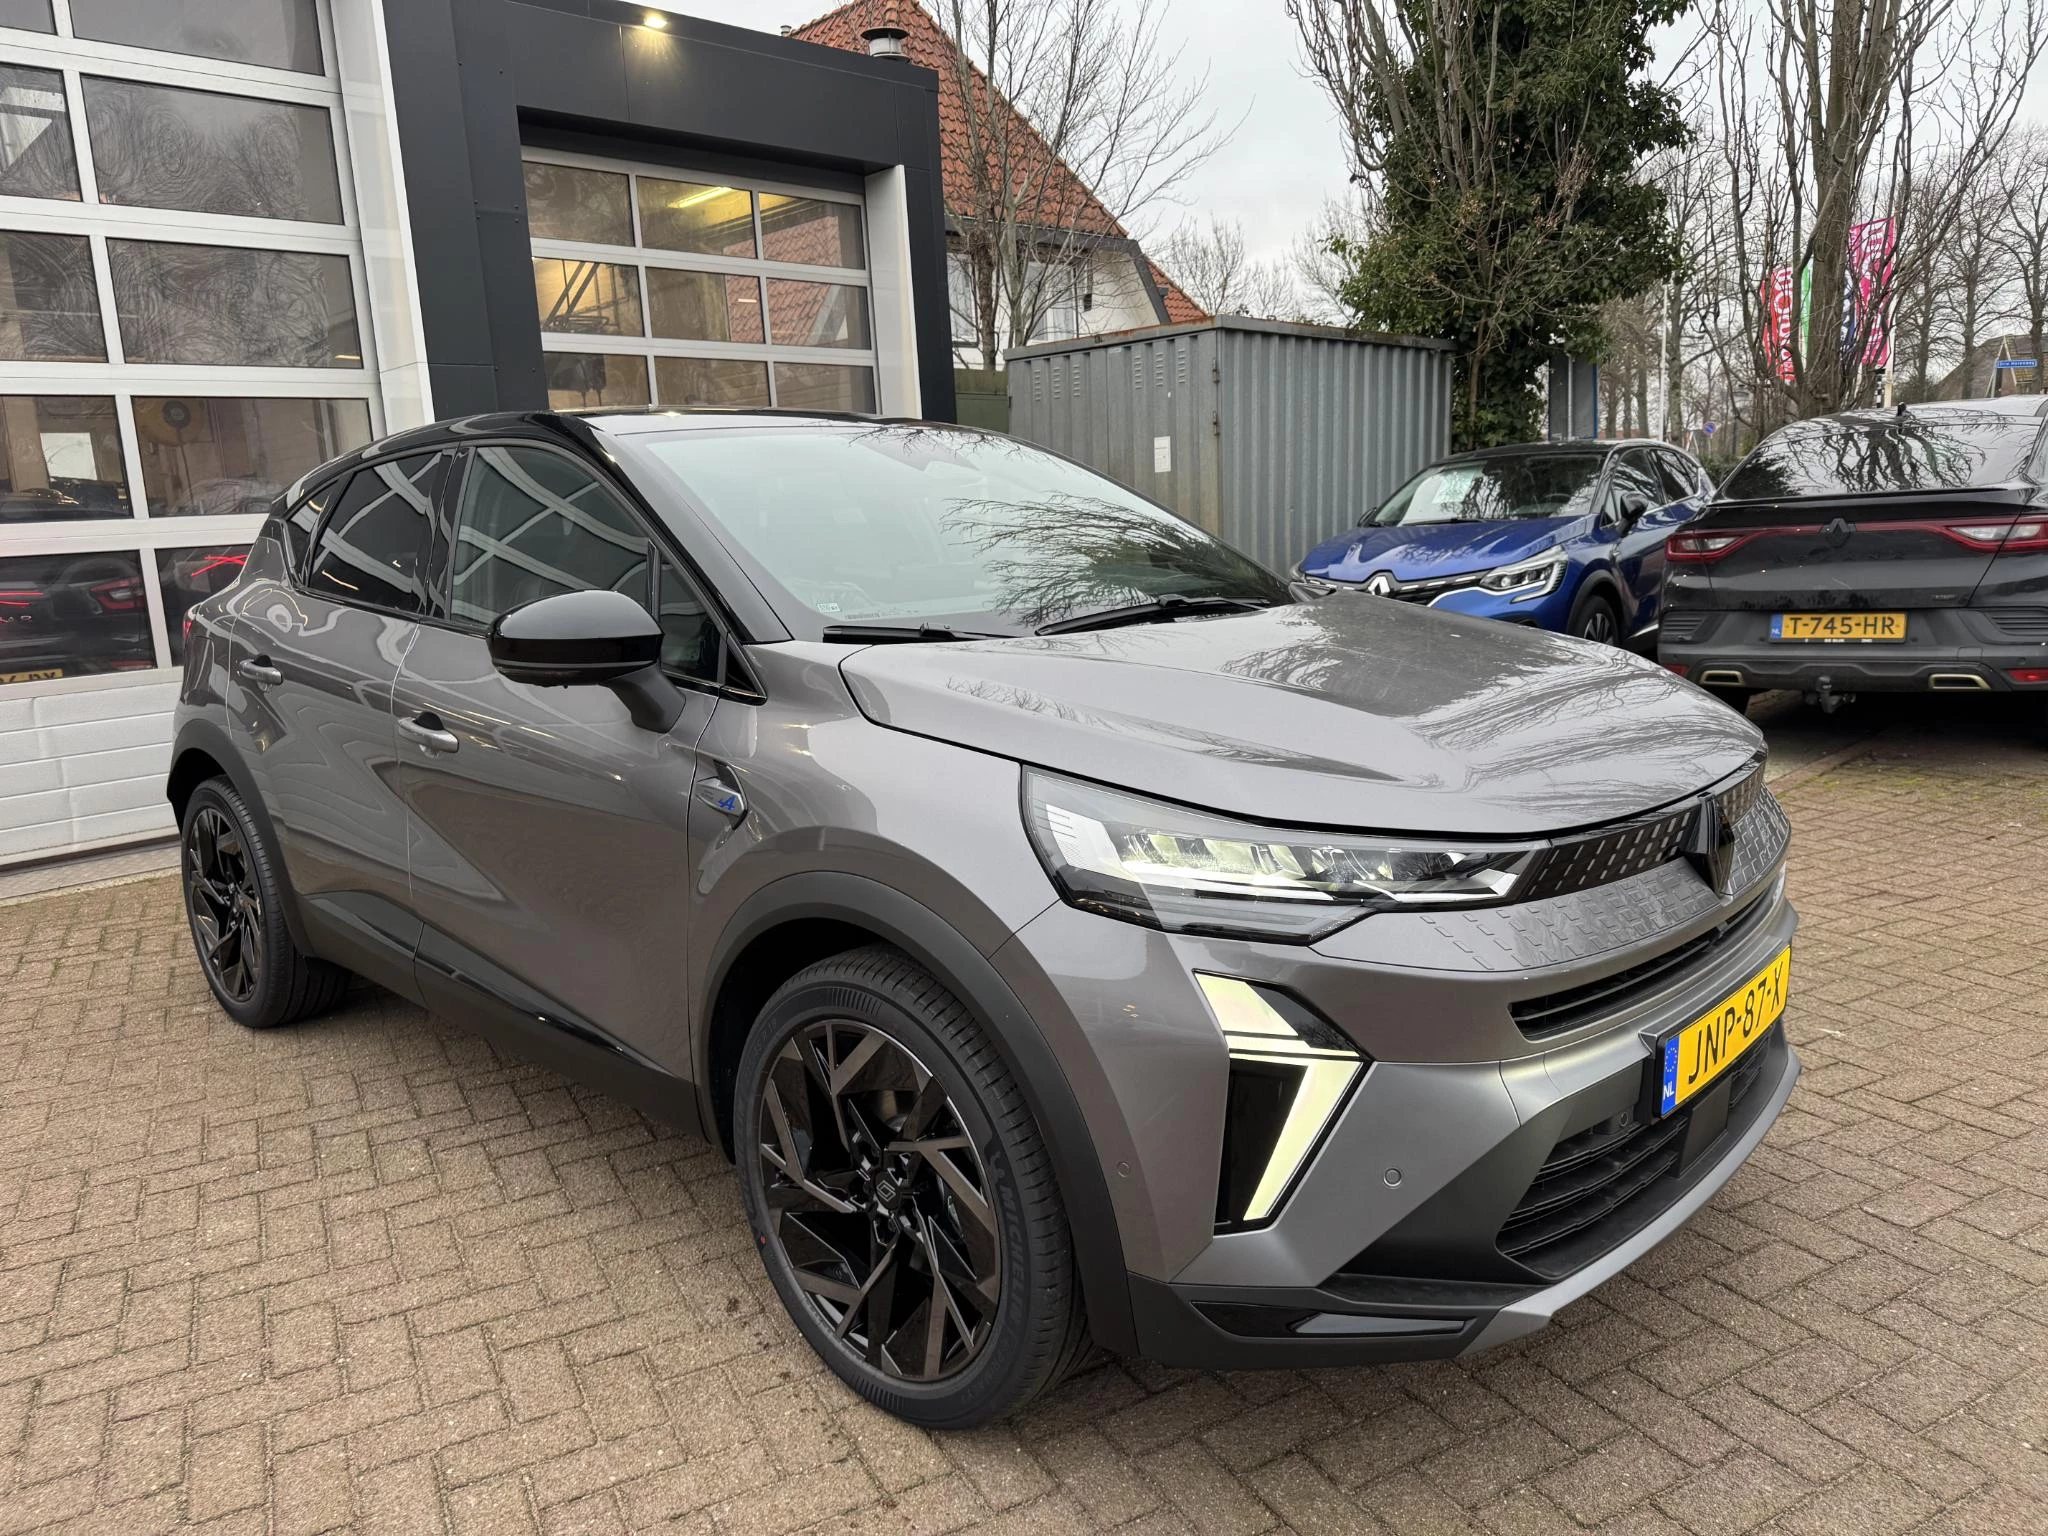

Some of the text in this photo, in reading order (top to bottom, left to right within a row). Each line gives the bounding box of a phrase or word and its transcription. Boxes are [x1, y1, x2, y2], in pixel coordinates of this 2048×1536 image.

[1789, 616, 1895, 635] T-745-HR
[1688, 961, 1784, 1085] JNP-87-X
[1662, 1080, 1675, 1100] NL
